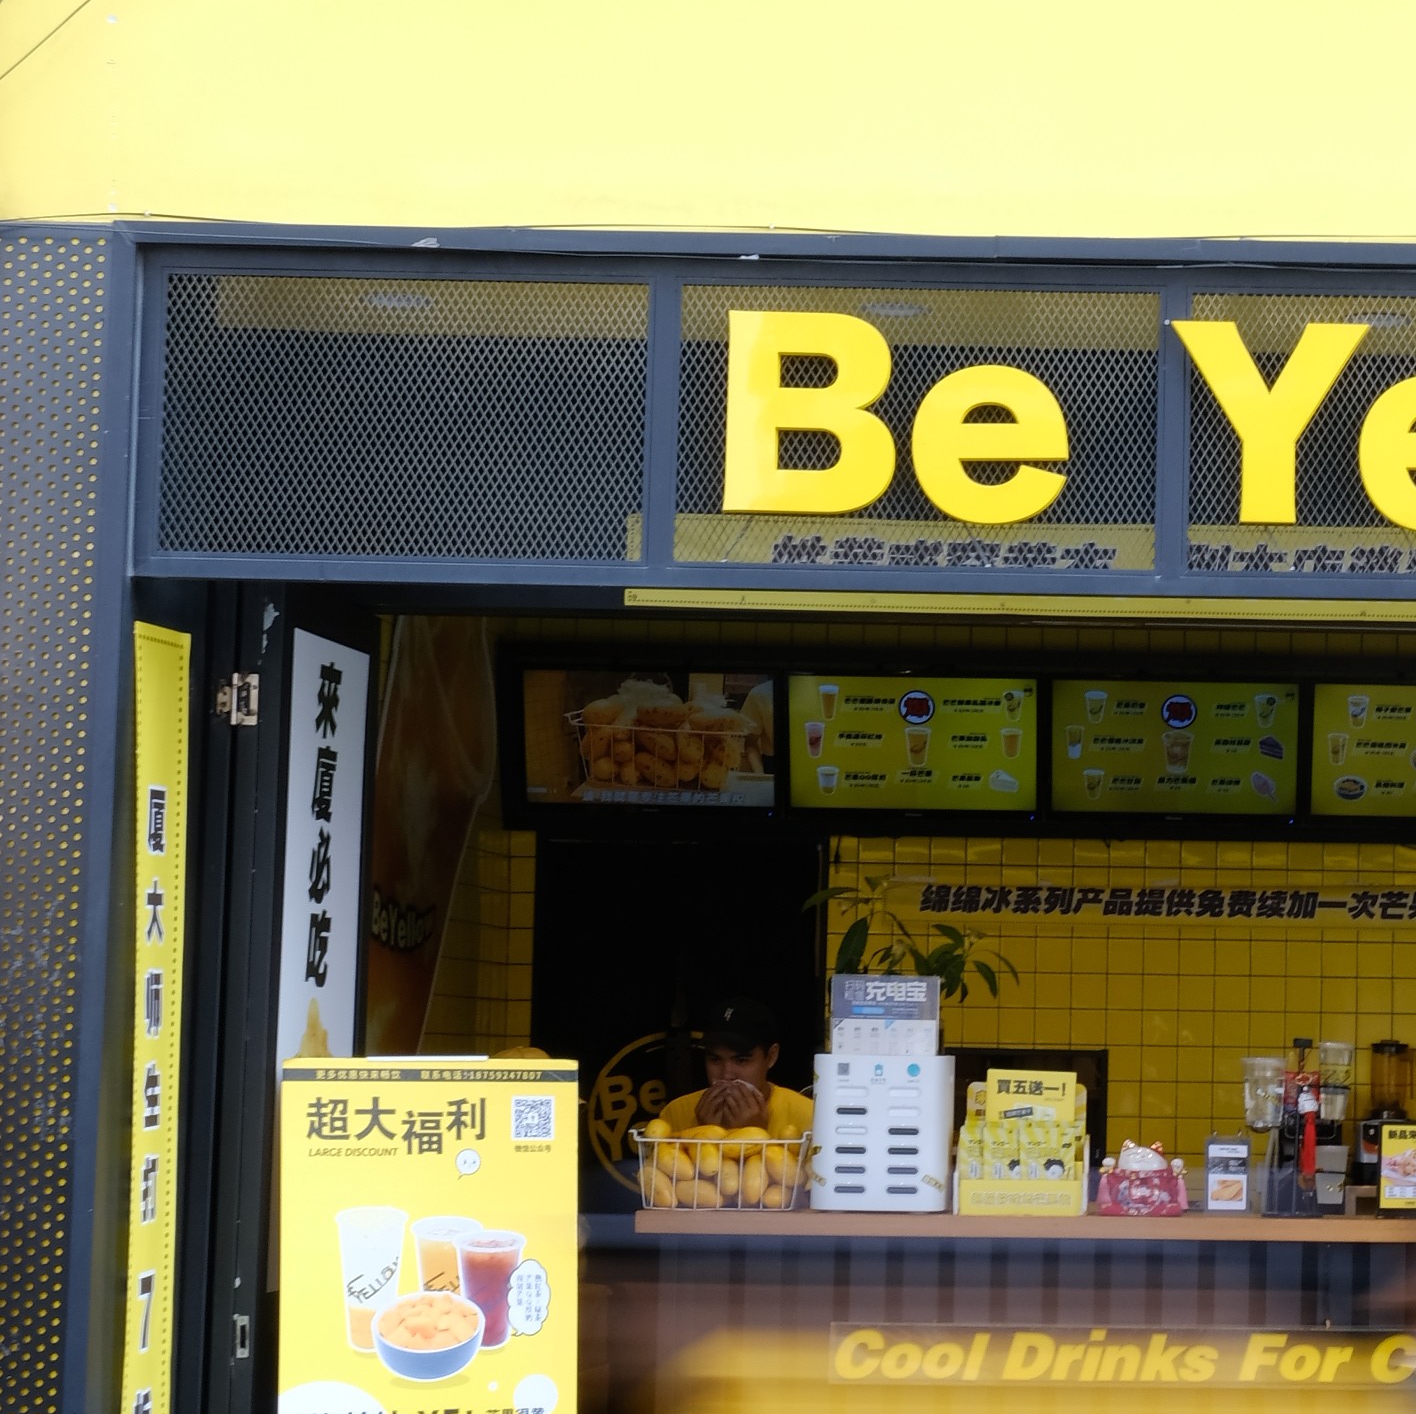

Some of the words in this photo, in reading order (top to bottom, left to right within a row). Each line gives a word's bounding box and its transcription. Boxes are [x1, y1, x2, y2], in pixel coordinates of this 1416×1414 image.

[723, 310, 1069, 524] Be
[305, 662, 343, 987] 来厦必吃
[865, 981, 928, 1002] 充电宝
[598, 1075, 667, 1121] Be
[307, 1097, 487, 1155] 超大福利
[309, 1148, 343, 1157] LARGE
[345, 1148, 398, 1157] DISCOUNT
[834, 1329, 991, 1381] Cool
[1001, 1329, 1219, 1383] Drinks
[1238, 1333, 1354, 1384] For
